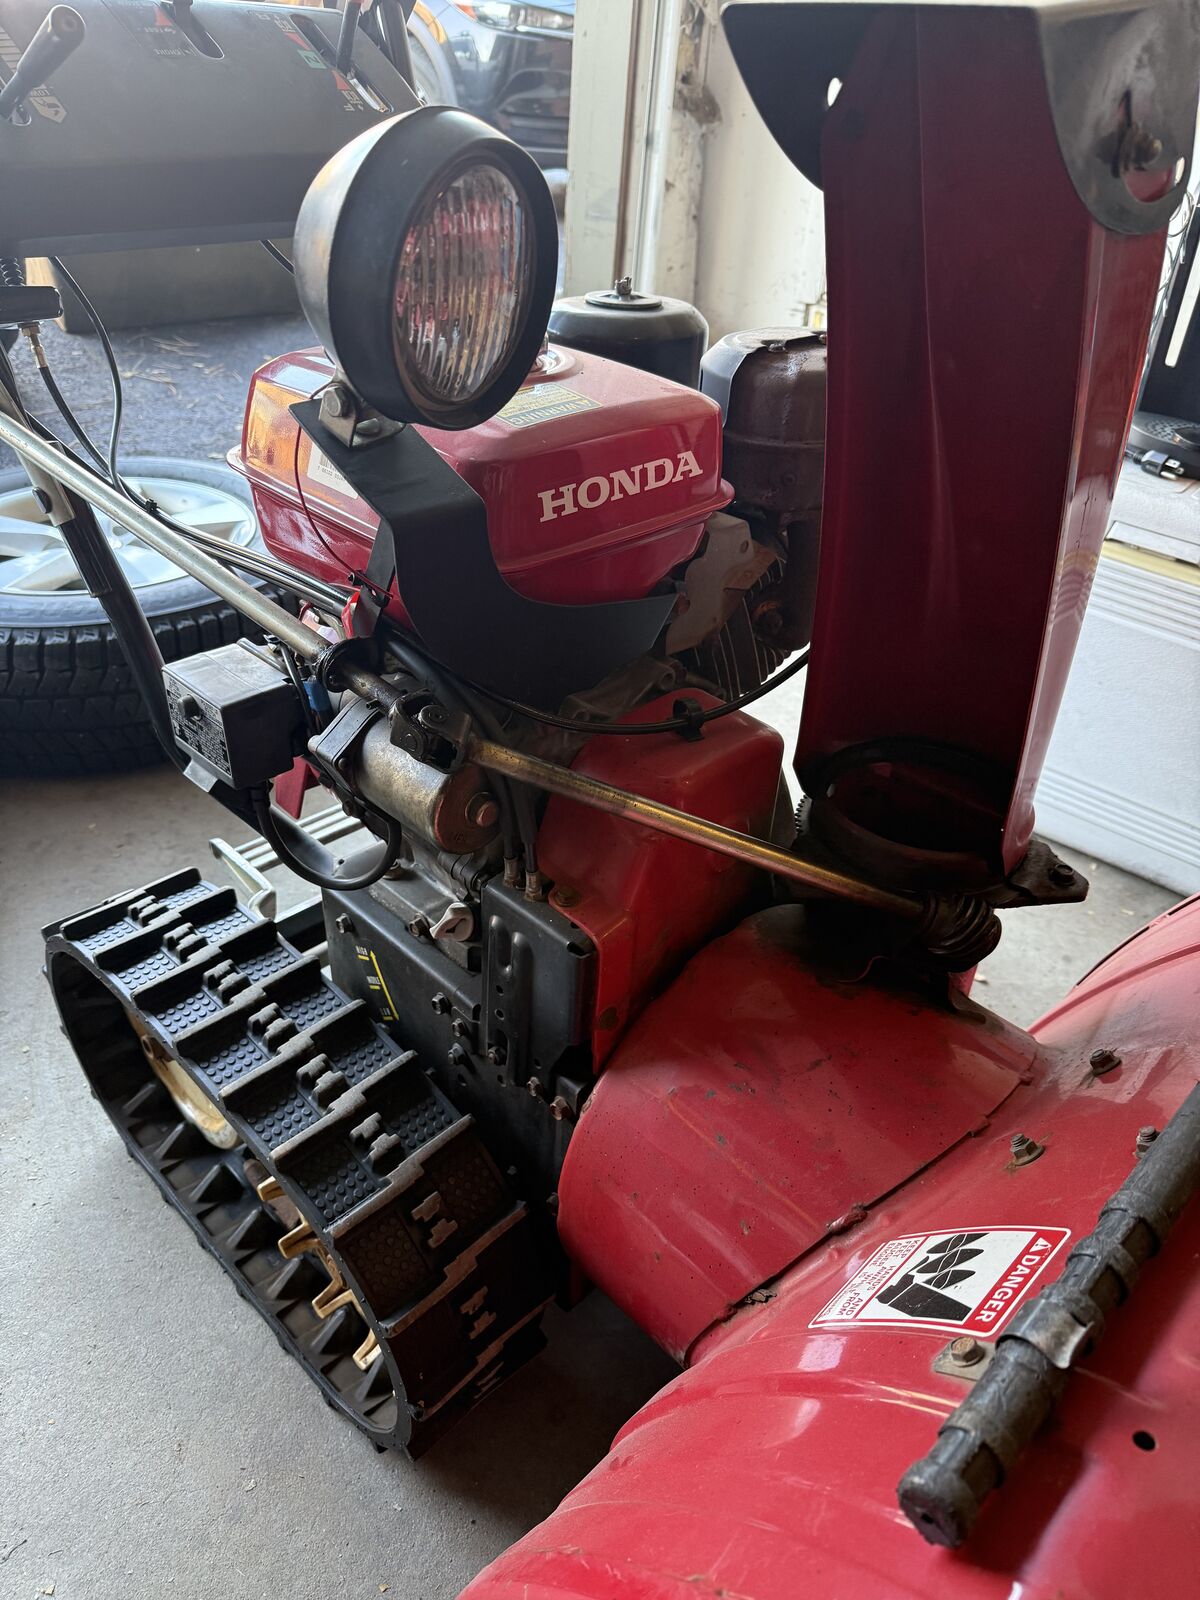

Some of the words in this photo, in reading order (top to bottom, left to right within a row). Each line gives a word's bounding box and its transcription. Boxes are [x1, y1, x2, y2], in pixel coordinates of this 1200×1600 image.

[510, 402, 577, 425] WARNING
[537, 450, 703, 523] HONDA
[869, 1242, 896, 1266] ENGINE
[876, 1242, 903, 1266] AUGER
[891, 1240, 912, 1257] FEET
[896, 1239, 920, 1258] KEEP
[864, 1266, 887, 1284] AWAY
[866, 1265, 897, 1290] HANDS
[974, 1254, 1041, 1322] DANGER
[835, 1292, 860, 1315] FROM
[844, 1297, 864, 1315] AND
